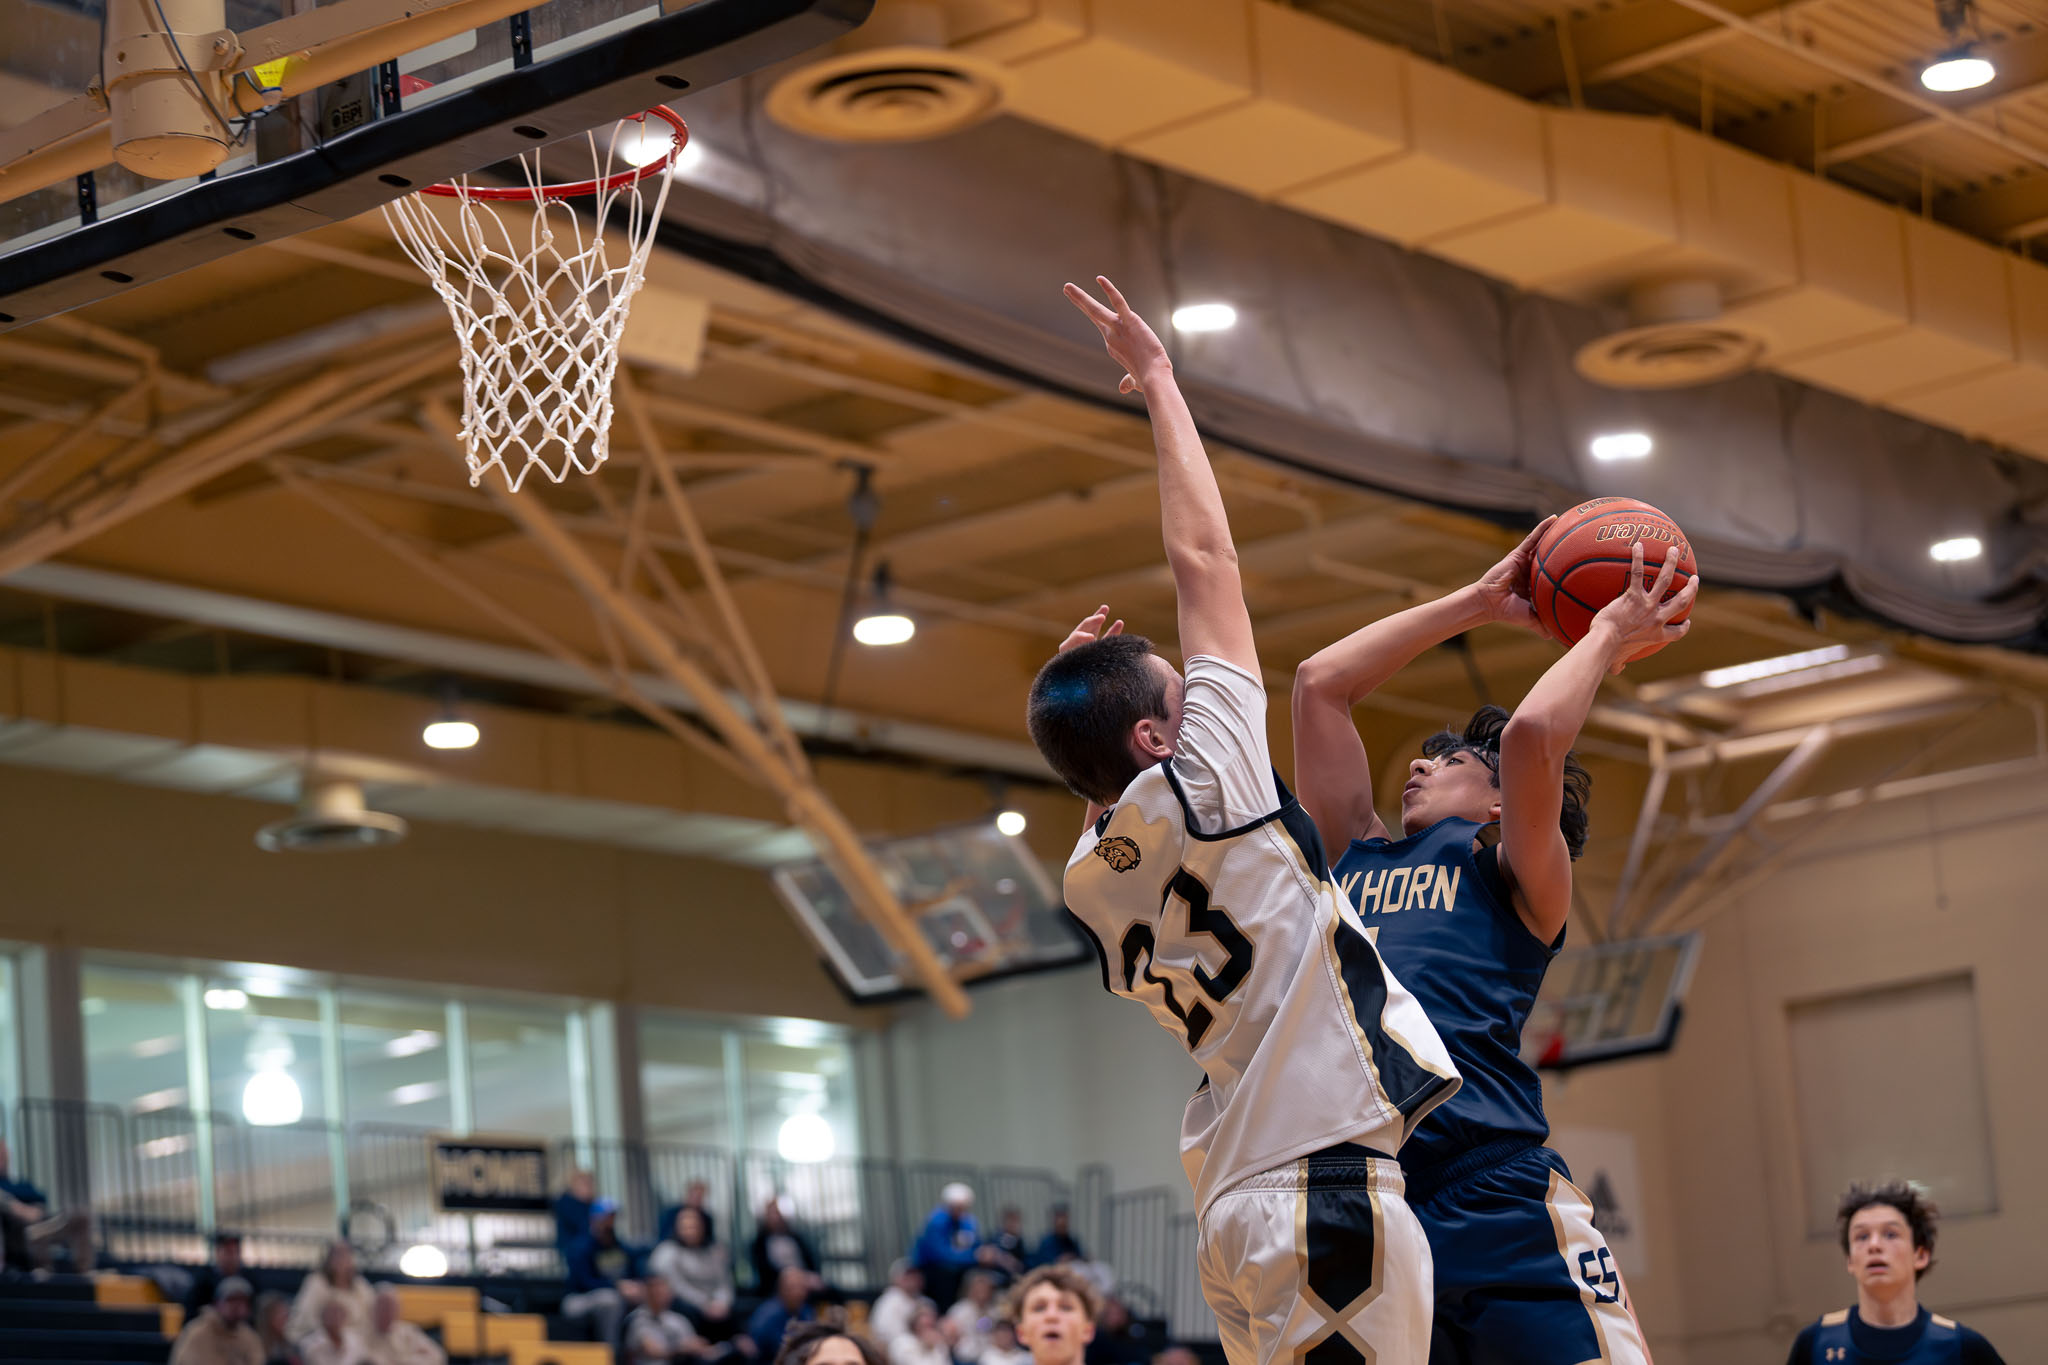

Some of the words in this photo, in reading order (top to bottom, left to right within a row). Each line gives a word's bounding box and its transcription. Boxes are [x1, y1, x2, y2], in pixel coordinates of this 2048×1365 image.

[1596, 523, 1690, 561] Baden
[1119, 863, 1256, 1052] 23
[434, 1148, 541, 1198] HOME
